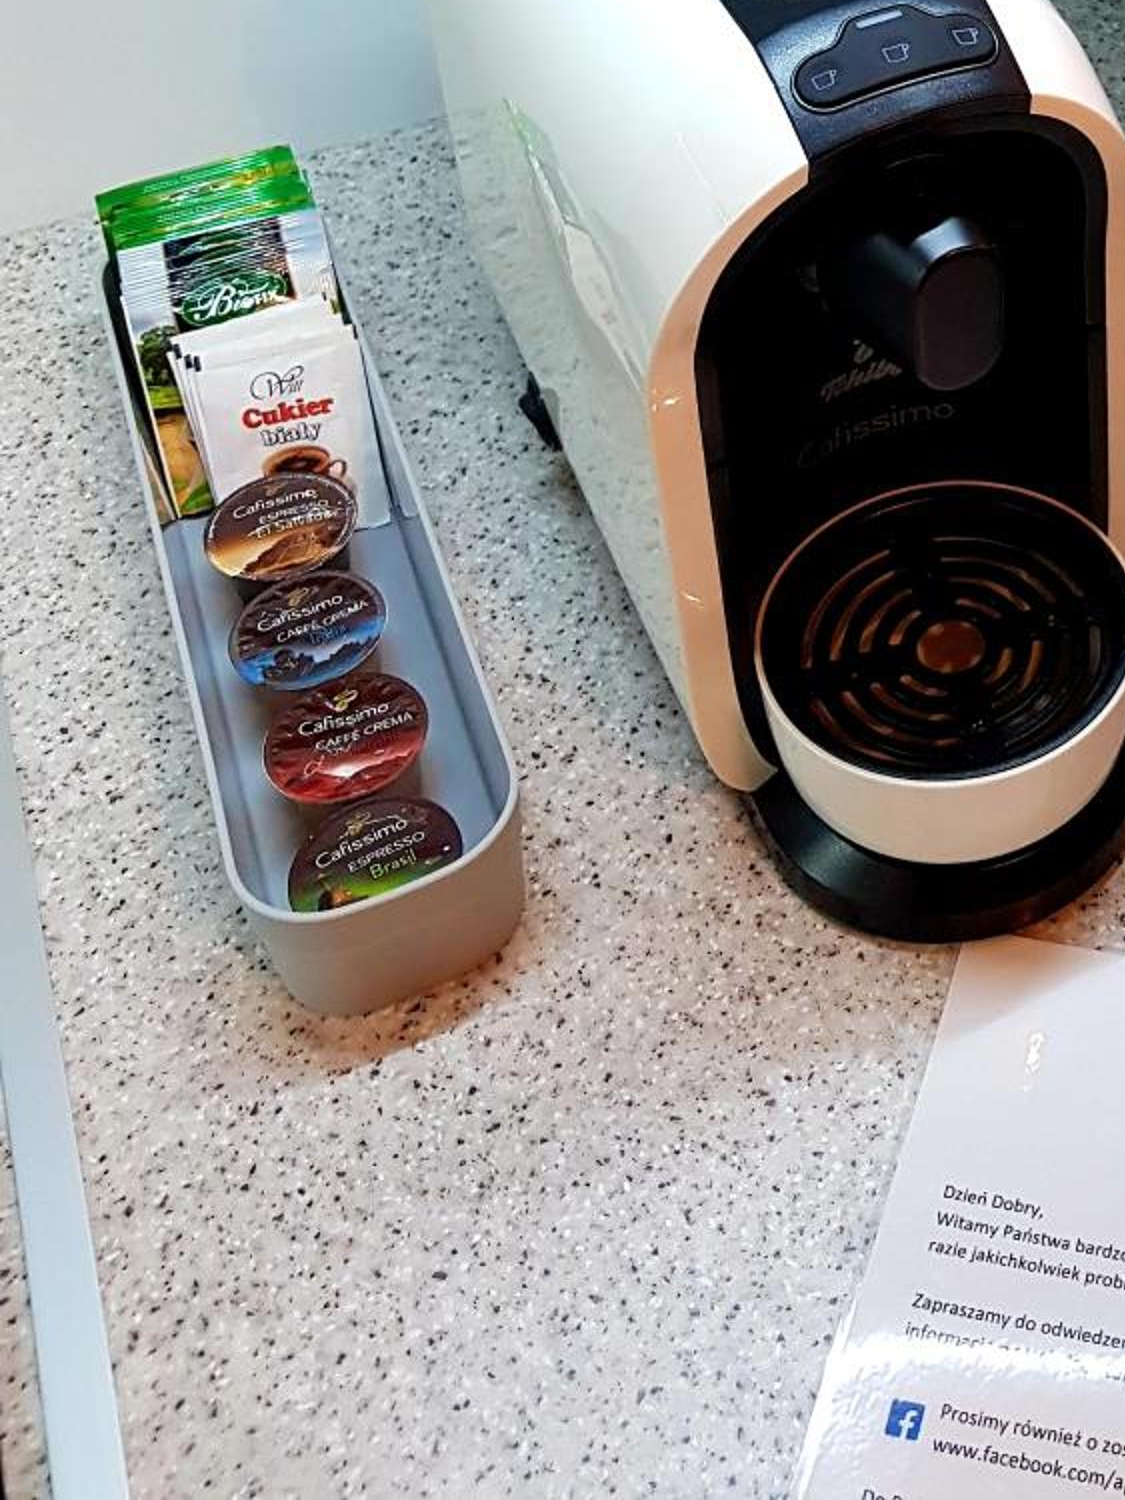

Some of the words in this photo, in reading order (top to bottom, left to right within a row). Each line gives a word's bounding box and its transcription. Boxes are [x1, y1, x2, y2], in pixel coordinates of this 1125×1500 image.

[242, 397, 335, 429] Cukier
[232, 488, 318, 519] Cafissimo
[256, 595, 344, 633] Cafissimo
[298, 703, 390, 737] Cafissimo
[363, 711, 414, 736] CREMA
[315, 818, 409, 869] Cafissimo
[347, 831, 426, 873] ESPRESSO
[369, 849, 417, 880] Brasil
[942, 1183, 988, 1206] Dzień
[991, 1193, 1044, 1221] Dobry,
[936, 1210, 1000, 1239] Witamy
[1003, 1223, 1071, 1252] Państwa
[927, 1238, 967, 1259] razie
[968, 1244, 1081, 1282] jakichkolwiek
[911, 1292, 1012, 1330] Zapraszamy
[1015, 1313, 1038, 1332] do
[940, 1403, 1010, 1435] Prosimy
[1013, 1419, 1082, 1448] również
[1085, 1435, 1098, 1452] o
